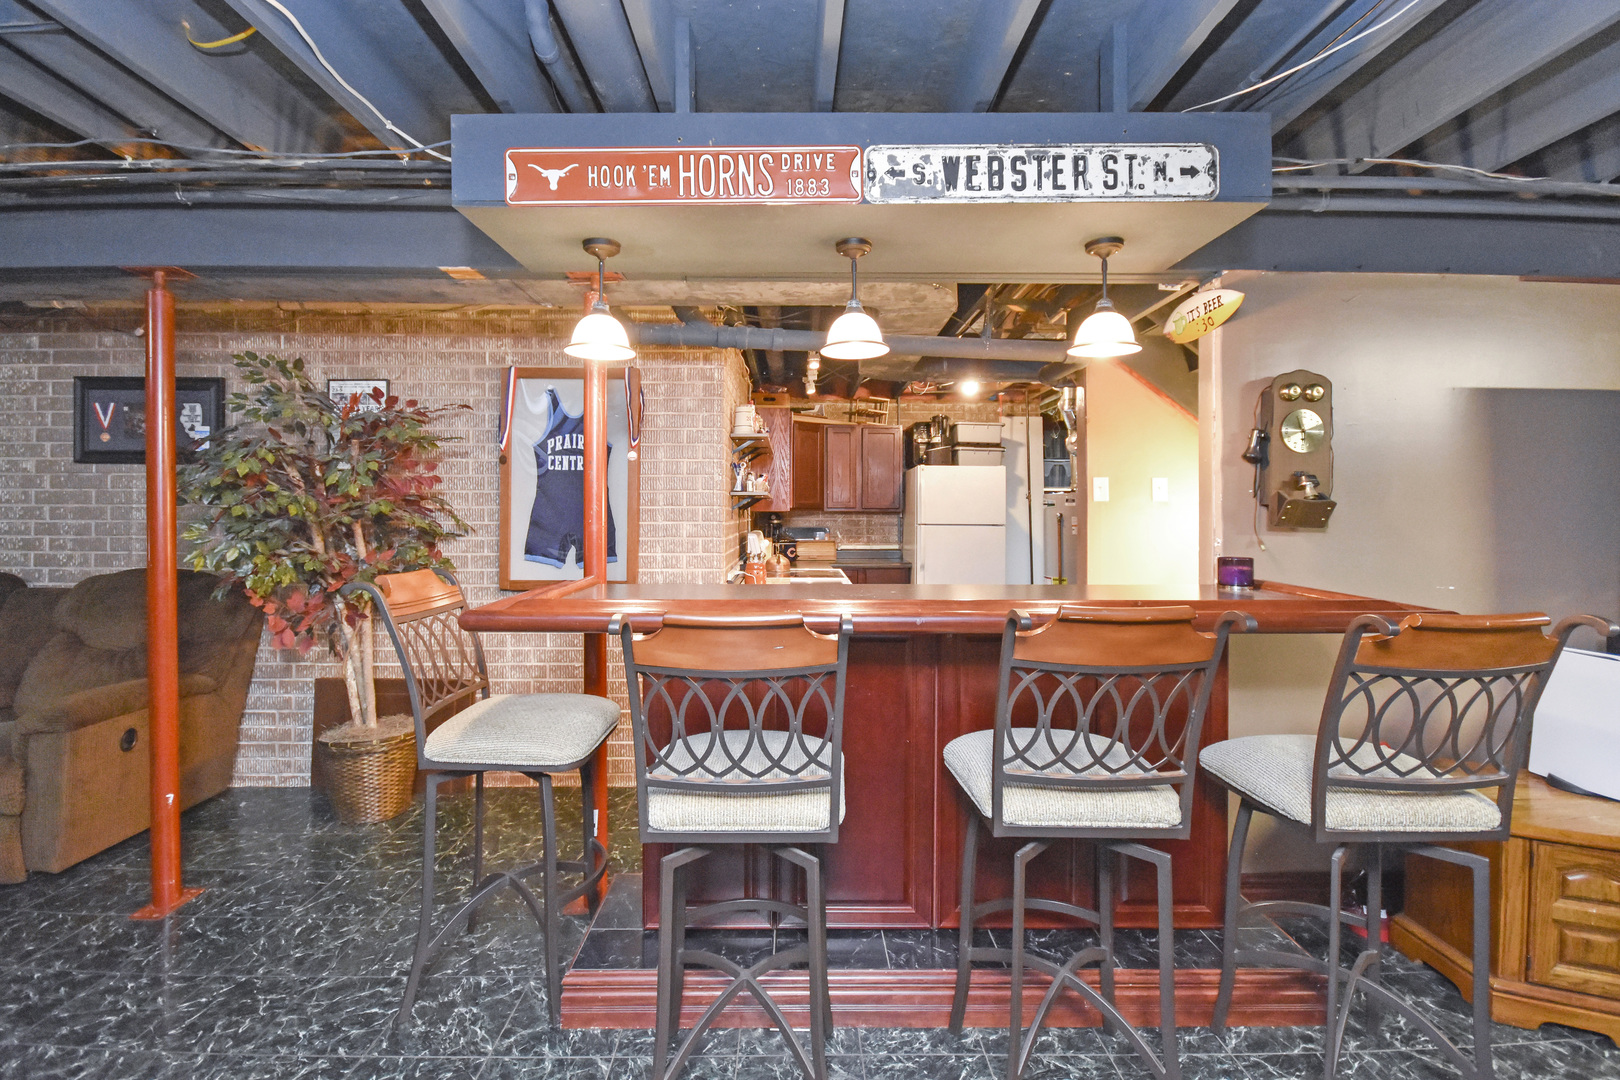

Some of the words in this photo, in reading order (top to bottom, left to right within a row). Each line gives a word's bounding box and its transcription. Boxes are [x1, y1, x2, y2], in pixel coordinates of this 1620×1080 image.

[588, 165, 636, 188] HOOK
[642, 164, 671, 187] 'EM
[678, 153, 775, 197] HORNS
[780, 153, 836, 171] DRIVE
[912, 163, 933, 186] S.
[942, 154, 1090, 192] WEBSTER
[1102, 153, 1146, 190] ST.
[1153, 160, 1174, 182] N.
[786, 178, 830, 197] 1883
[1203, 295, 1224, 316] BEER
[547, 433, 585, 455] PRAIR
[547, 455, 585, 471] CENTR
